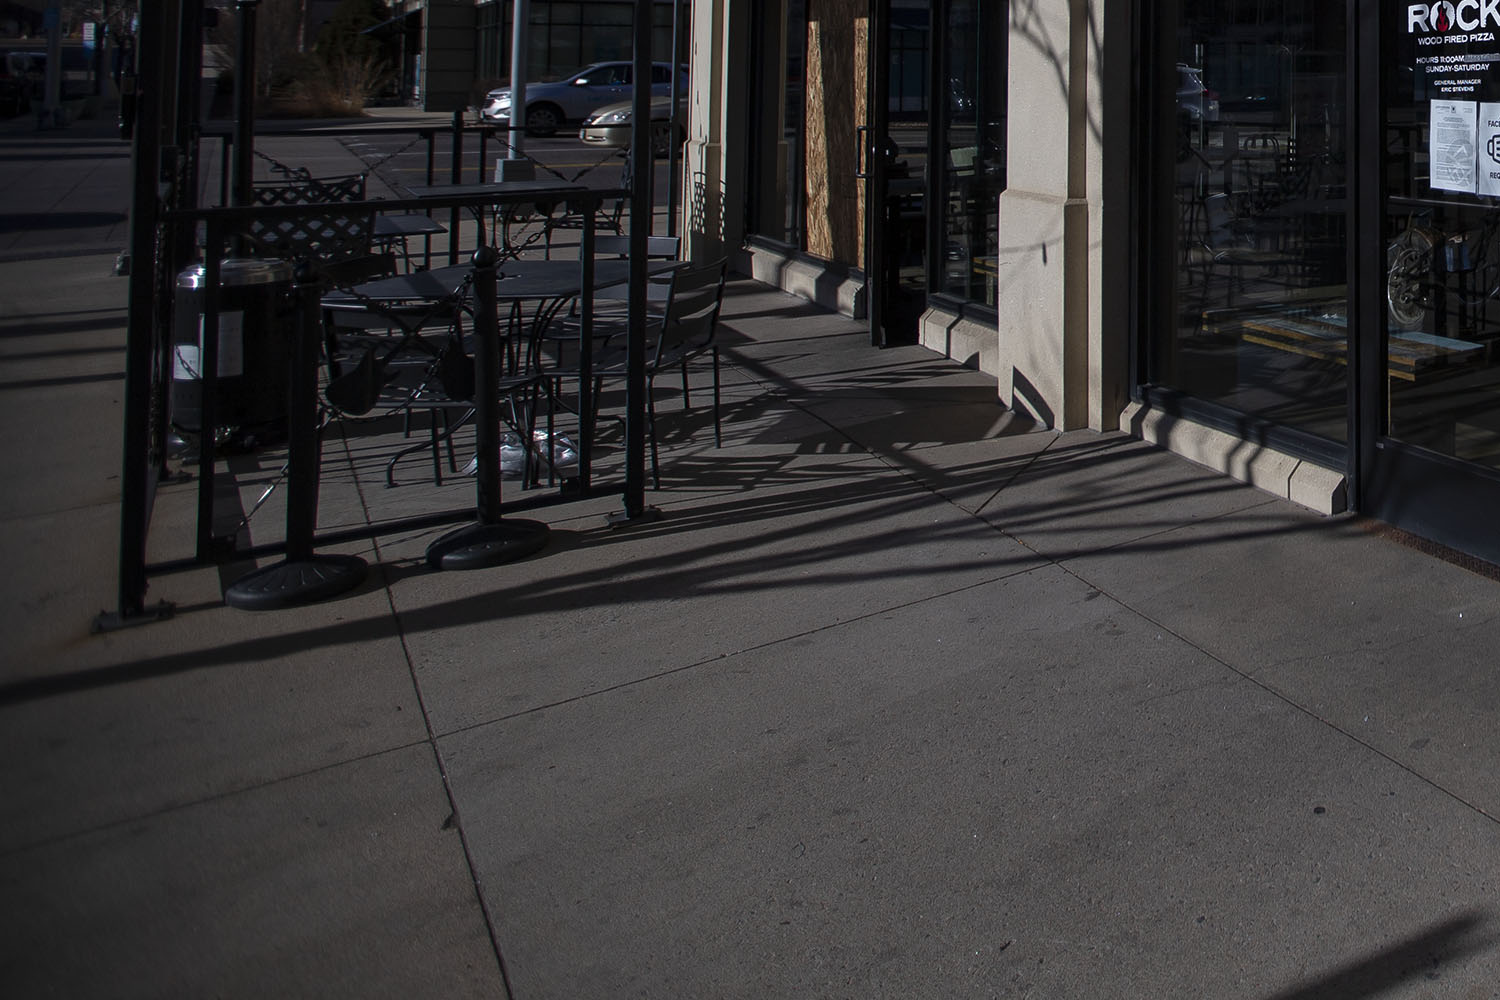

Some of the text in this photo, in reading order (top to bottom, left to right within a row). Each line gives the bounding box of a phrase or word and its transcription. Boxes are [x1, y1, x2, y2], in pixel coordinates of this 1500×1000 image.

[1418, 32, 1495, 45] WOOD FIRED PIZZA
[1416, 56, 1439, 64] HOURS
[1425, 63, 1490, 73] SUNDAY-SATURDAY
